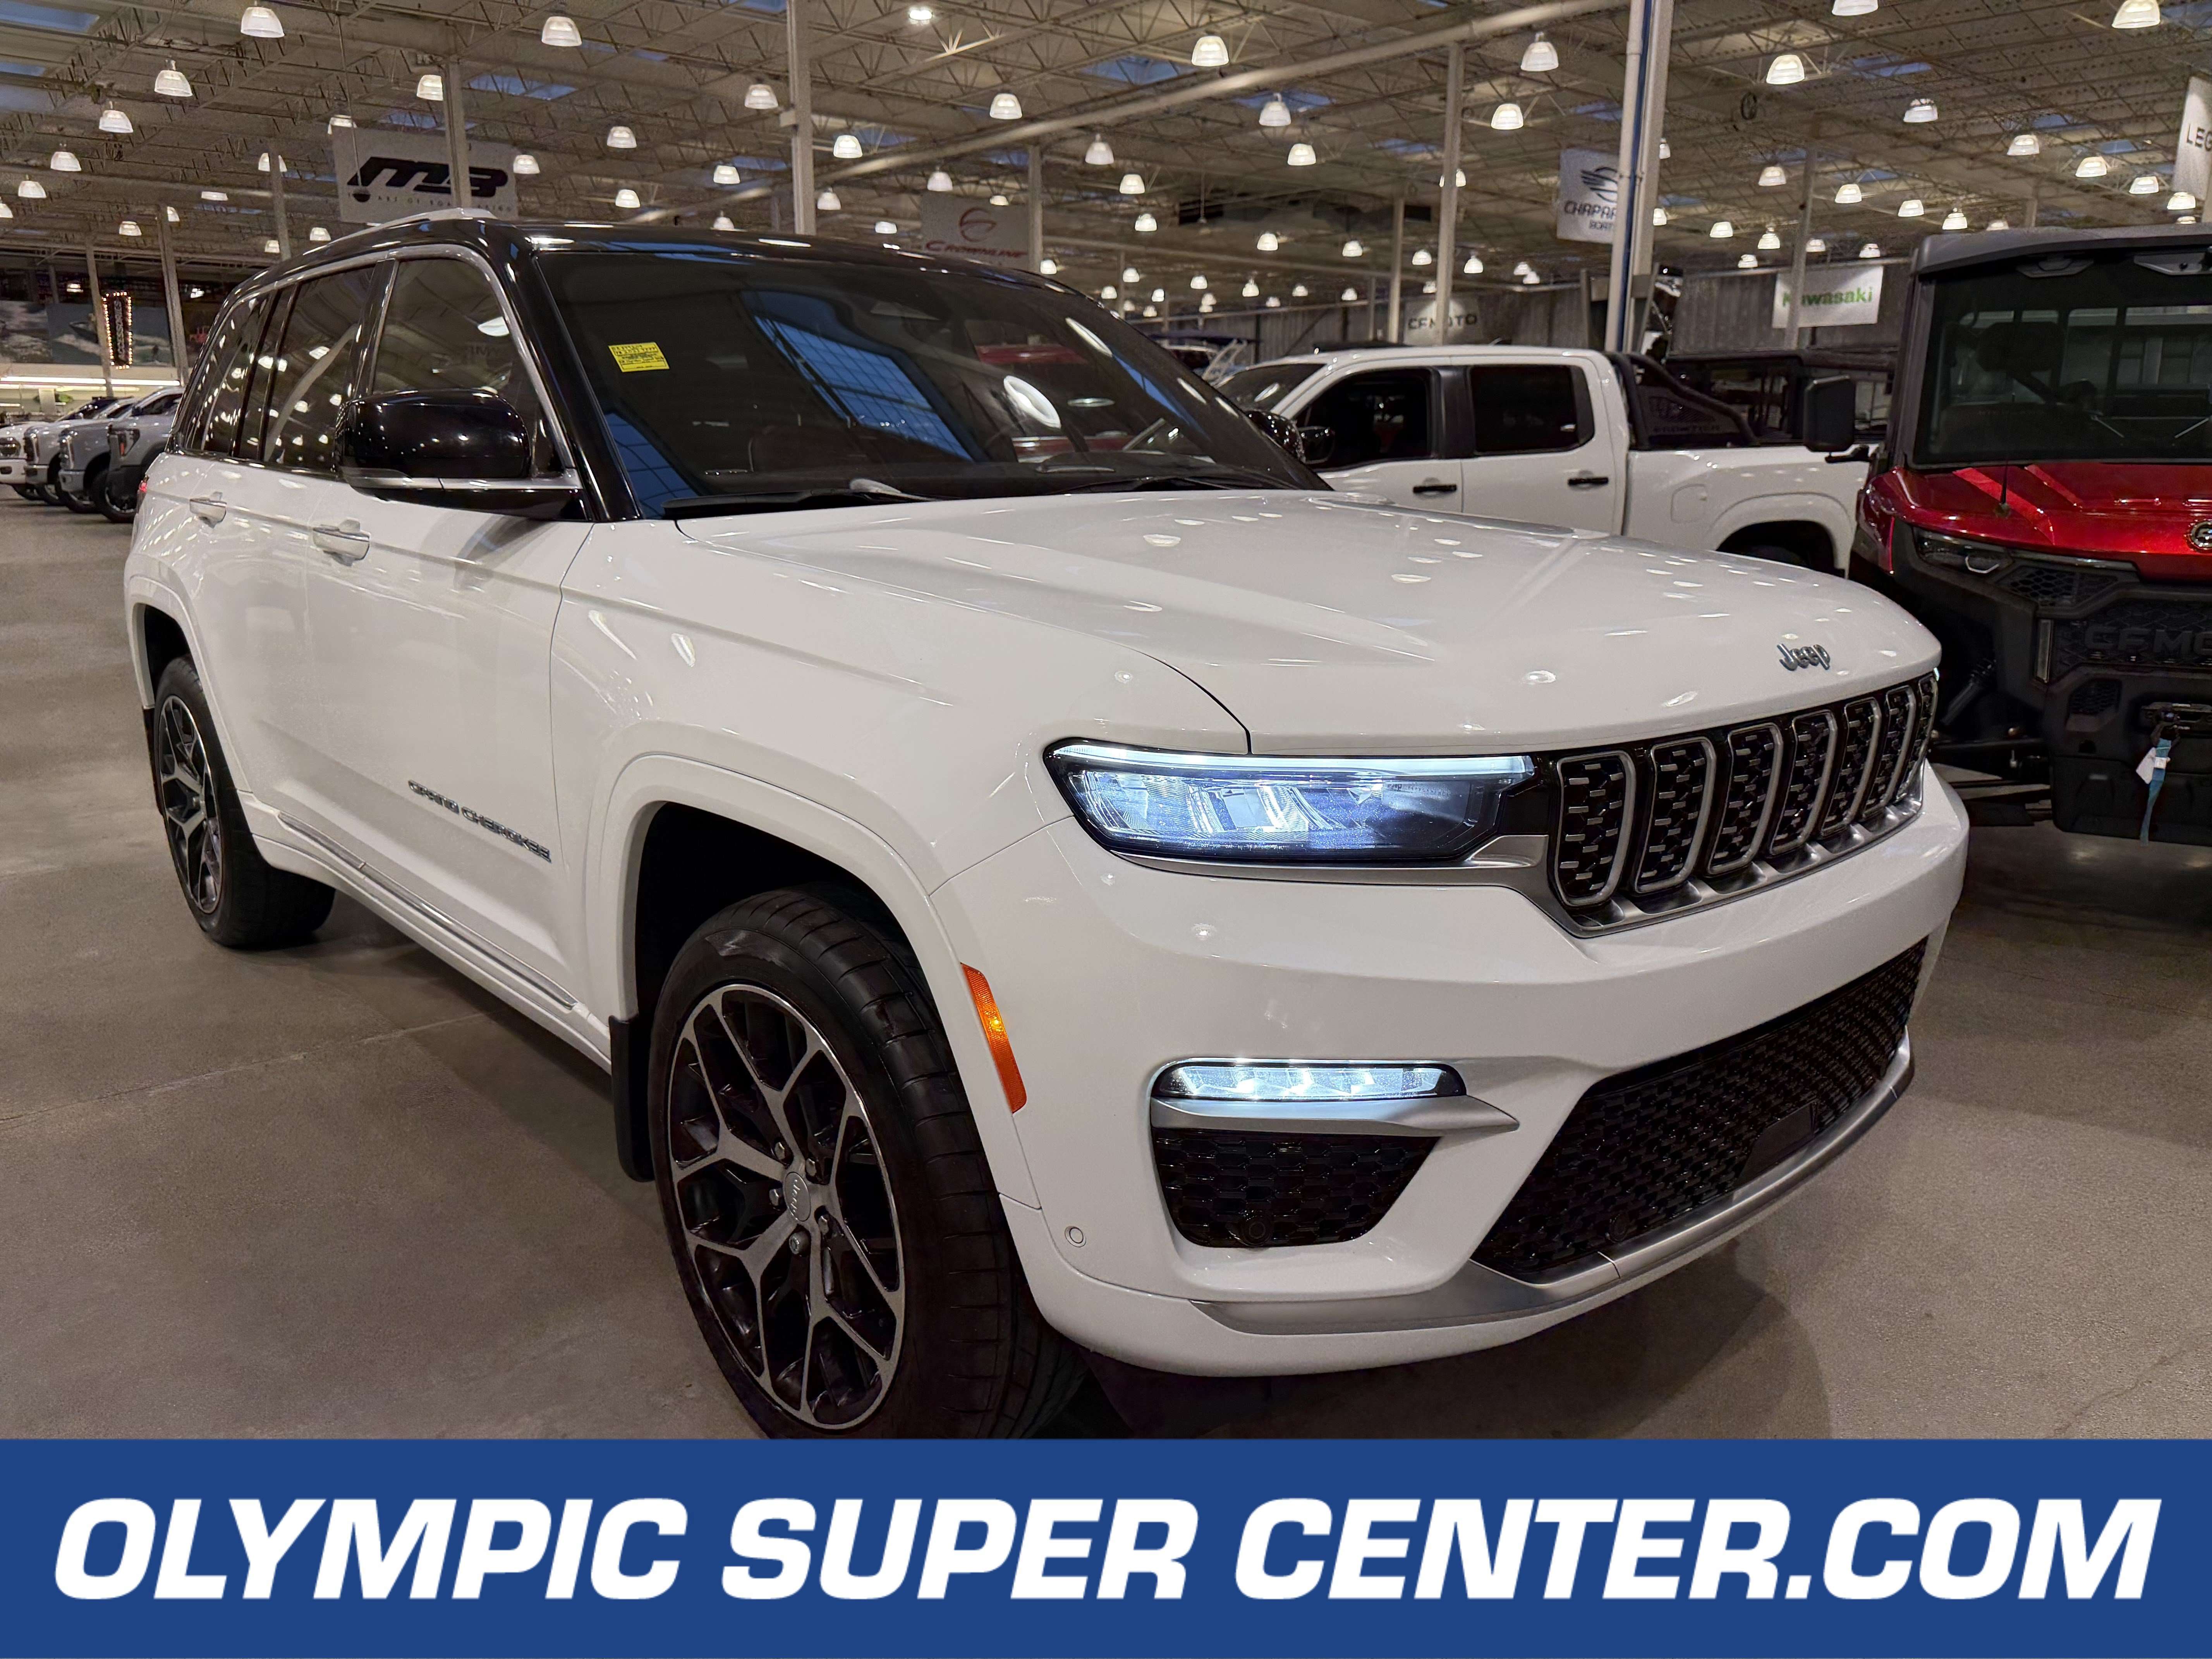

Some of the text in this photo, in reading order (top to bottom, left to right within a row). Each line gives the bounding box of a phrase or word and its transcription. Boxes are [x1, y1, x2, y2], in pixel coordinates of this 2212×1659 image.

[1777, 644, 1831, 671] Jeep
[408, 780, 552, 863] GRAND CHEROKEE
